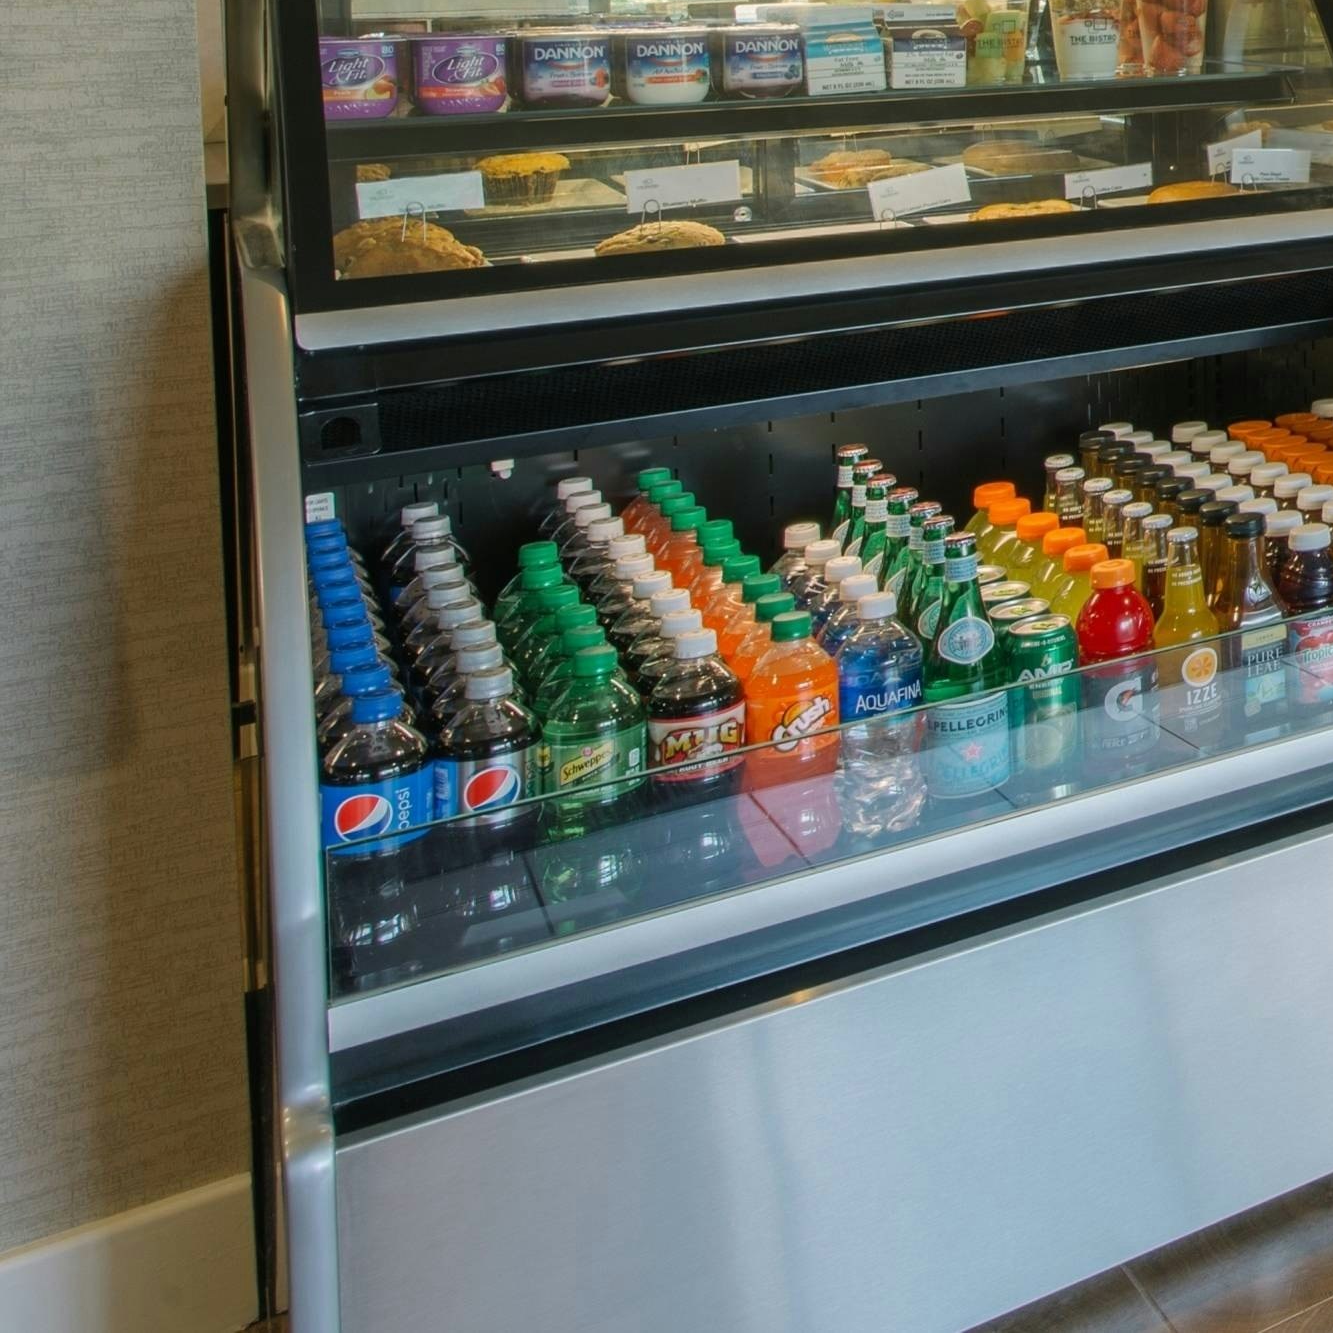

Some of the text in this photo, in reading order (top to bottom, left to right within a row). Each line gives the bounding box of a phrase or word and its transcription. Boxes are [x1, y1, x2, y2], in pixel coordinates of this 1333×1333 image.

[735, 37, 799, 54] DANNON
[1069, 33, 1117, 43] THE BISTRO
[534, 45, 606, 61] DANNON
[636, 41, 705, 58] DANNON
[328, 56, 370, 75] Light
[447, 55, 485, 72] Light
[1247, 647, 1283, 665] PURE
[1247, 660, 1281, 678] LEAF
[855, 679, 922, 714] AQUAFINA
[1187, 682, 1218, 706] IZZE
[773, 696, 832, 752] Crush
[927, 707, 1008, 733] .PELLEGRIN
[665, 718, 738, 758] MUG
